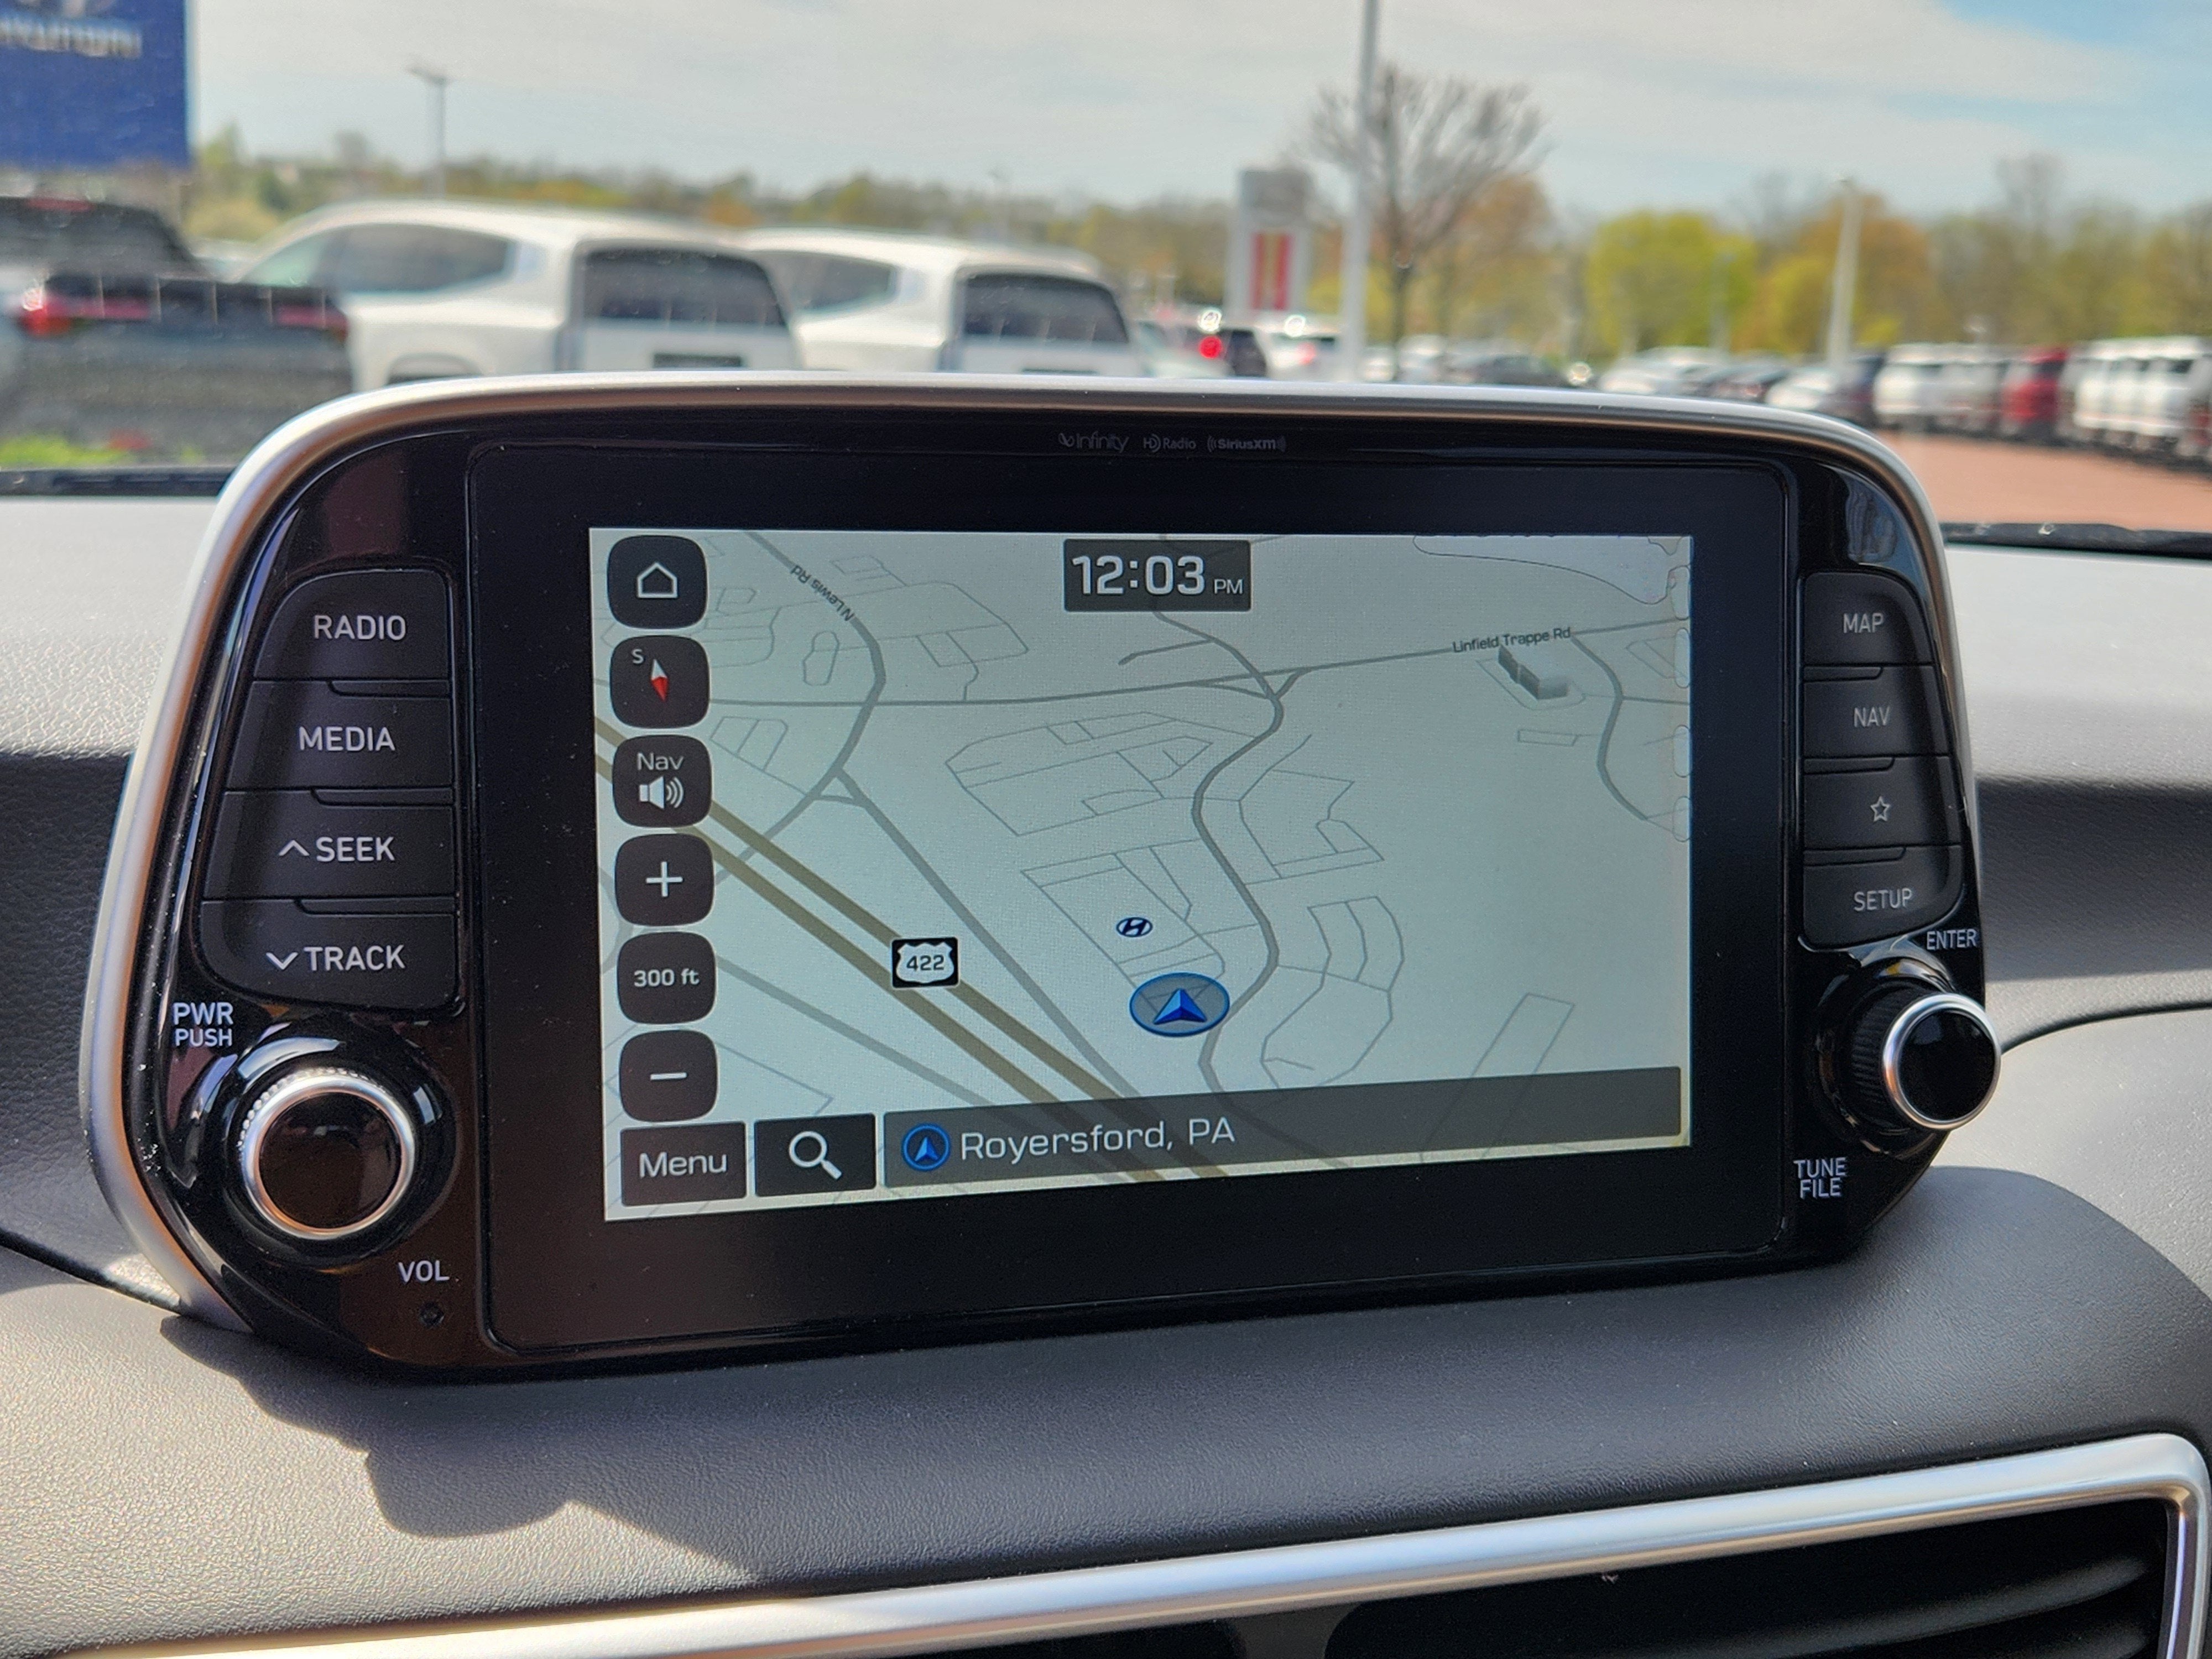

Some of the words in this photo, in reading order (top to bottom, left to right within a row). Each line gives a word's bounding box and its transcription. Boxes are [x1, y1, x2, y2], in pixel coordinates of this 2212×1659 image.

[1162, 436, 1197, 450] Radio
[790, 565, 812, 584] Rd
[1072, 555, 1206, 595] 12:03
[1214, 578, 1244, 594] PM
[811, 579, 845, 612] Lewis
[313, 614, 408, 641] RADIO
[1843, 613, 1884, 633] MAP
[1452, 636, 1499, 653] Linfield
[1502, 631, 1549, 646] Trappe
[1552, 627, 1571, 639] Rd
[632, 649, 644, 664] S
[1853, 707, 1891, 728] NAV
[299, 725, 396, 752] MEDIA
[636, 753, 685, 771] Nav
[316, 836, 396, 863] SEEK
[1853, 888, 1912, 911] SETUP
[1926, 928, 1976, 951] ENTER
[305, 945, 406, 972] TRACK
[905, 954, 945, 971] 422
[634, 969, 675, 987] 300
[680, 968, 700, 985] ft
[173, 1001, 234, 1025] PWR
[175, 1028, 232, 1047] PUSH
[961, 1121, 1173, 1165] Royersford,
[1188, 1117, 1235, 1145] PA
[639, 1151, 727, 1178] Menu
[1793, 1157, 1846, 1179] TUNE
[1800, 1177, 1841, 1199] FILE
[398, 1260, 450, 1282] VOL
